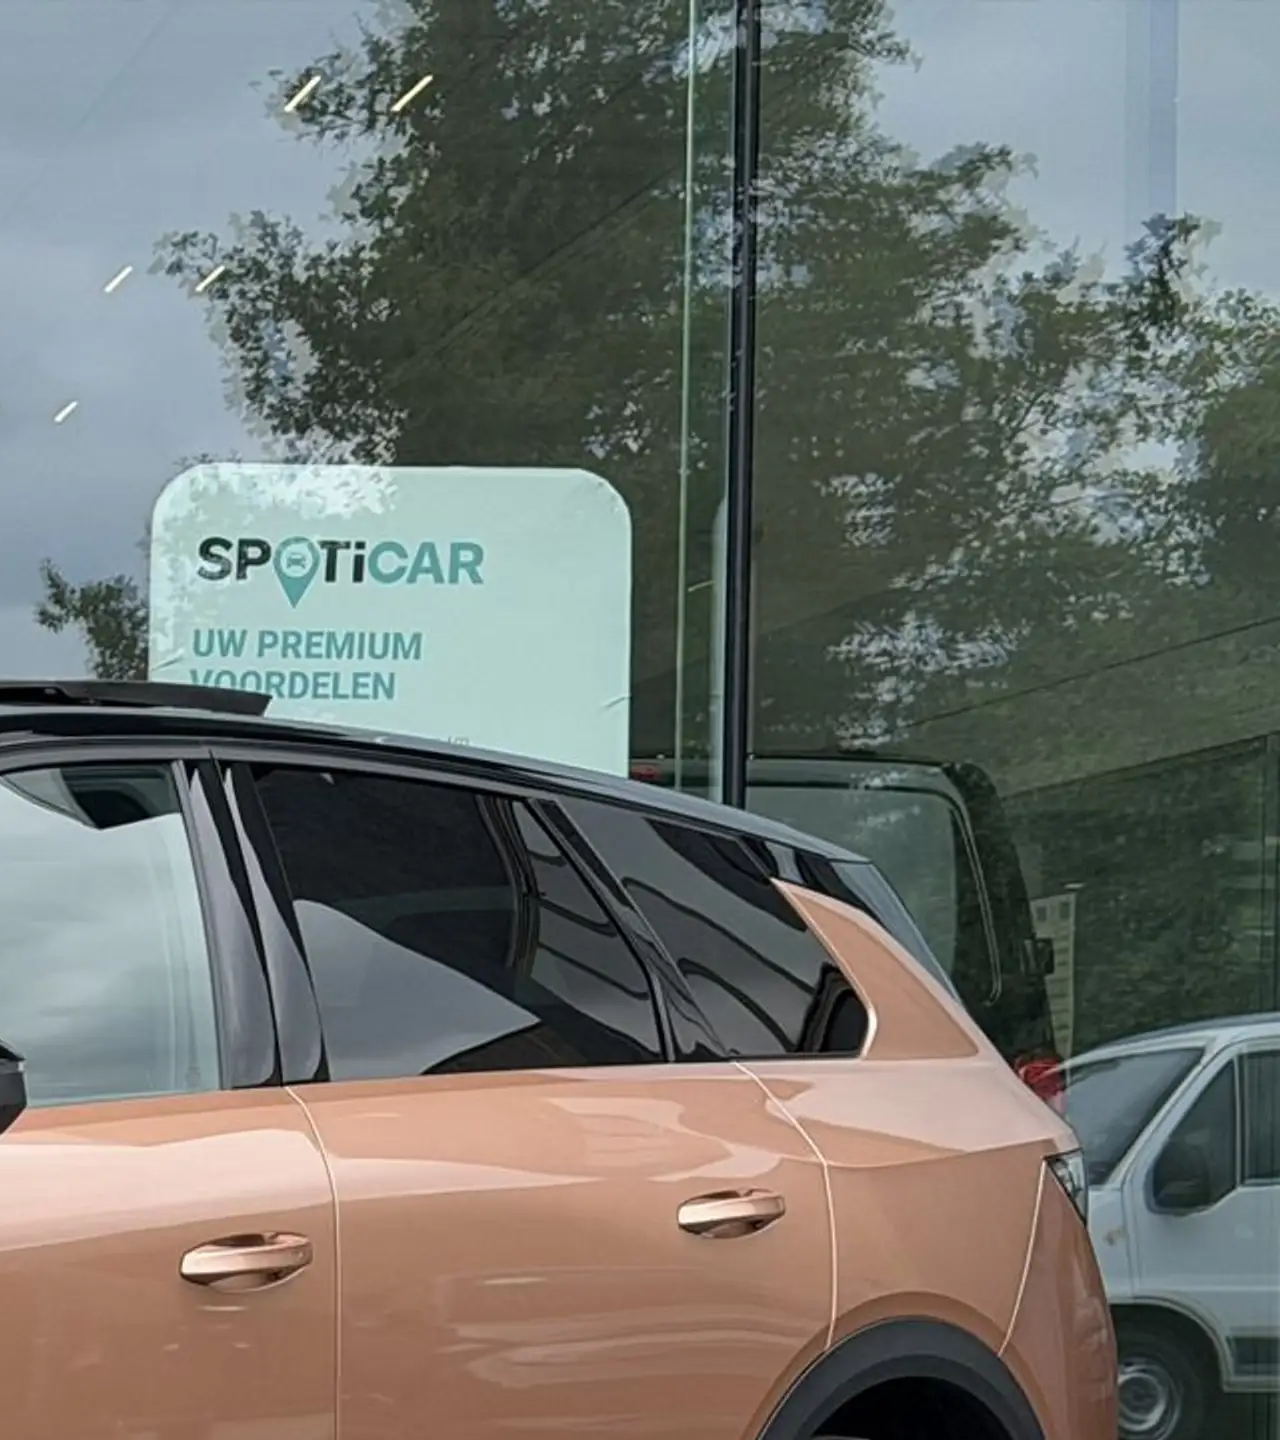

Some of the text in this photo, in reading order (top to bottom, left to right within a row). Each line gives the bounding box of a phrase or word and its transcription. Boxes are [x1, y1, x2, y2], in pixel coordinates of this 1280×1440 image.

[193, 629, 423, 660] UW PREMIUM
[190, 669, 396, 700] VOORDELEN
